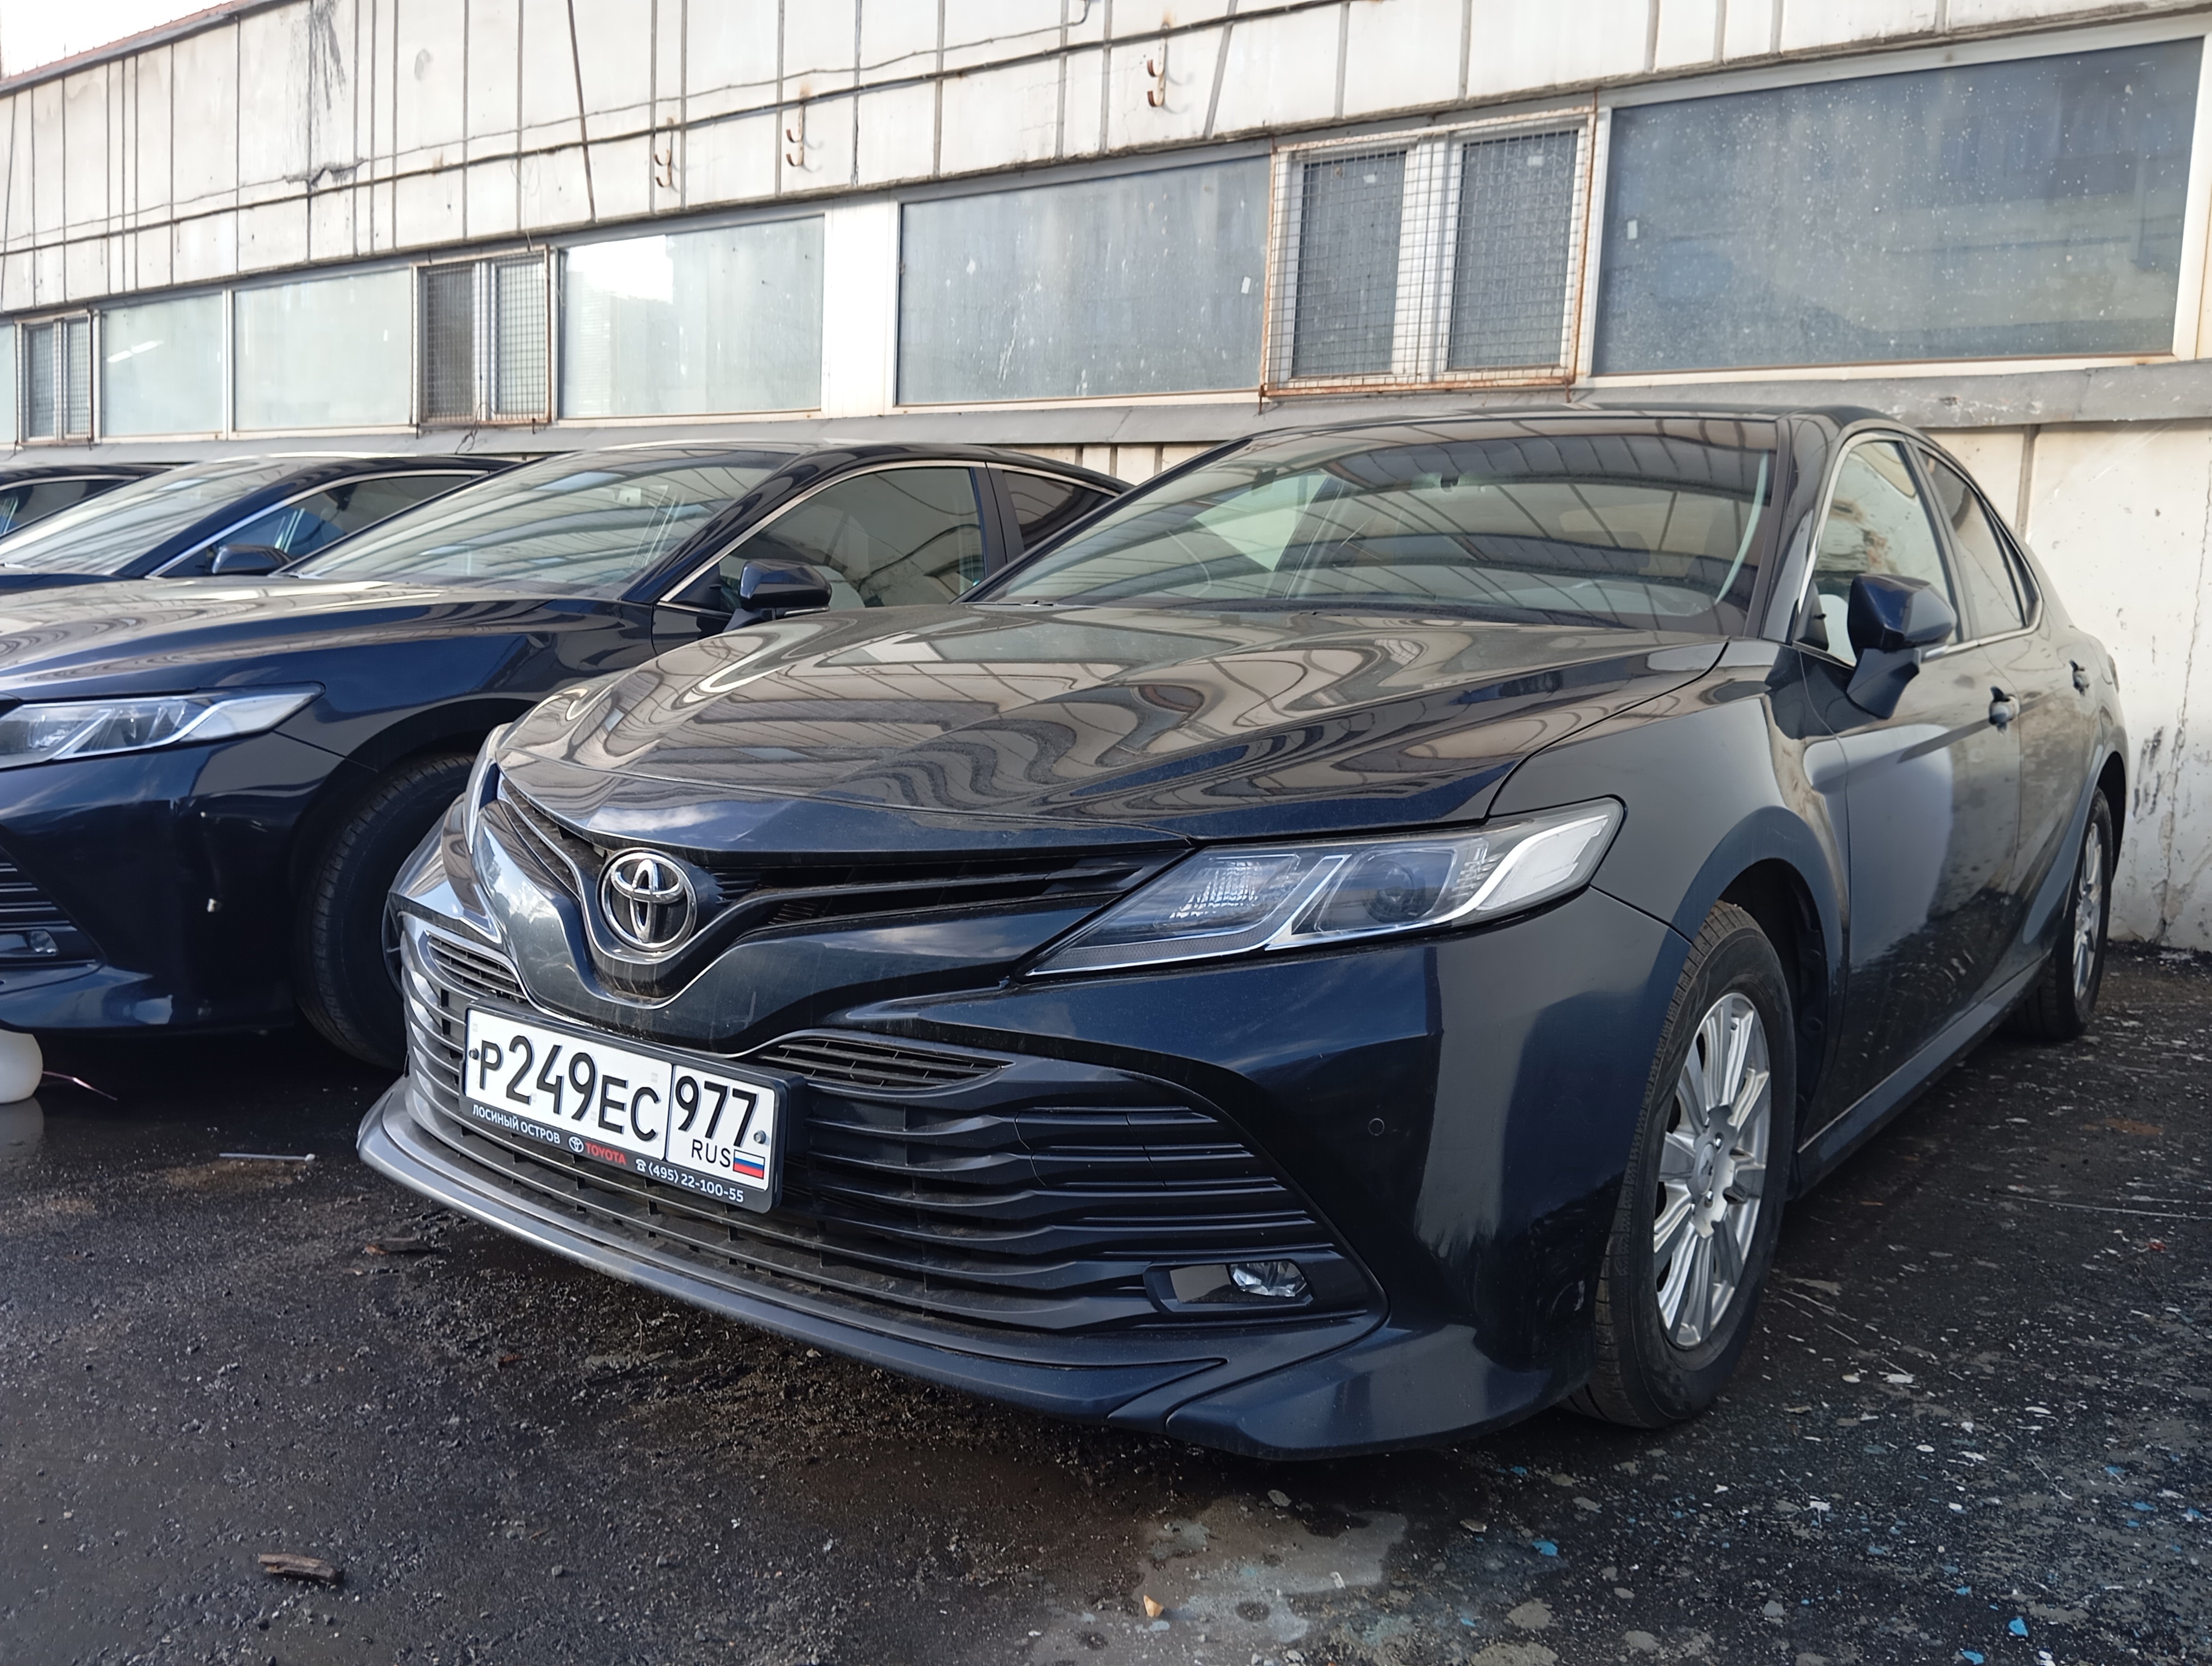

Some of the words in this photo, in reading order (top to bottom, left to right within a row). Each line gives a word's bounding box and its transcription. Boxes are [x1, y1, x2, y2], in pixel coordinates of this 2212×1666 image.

[473, 1104, 519, 1131] ЛОСИНЫЙ
[520, 1121, 561, 1144] ОСТРОВ
[674, 1075, 758, 1147] 977
[585, 1142, 626, 1165] TOYOTA
[691, 1139, 731, 1168] RUS
[648, 1162, 678, 1184] (495)
[681, 1173, 744, 1202] 22-100-55
